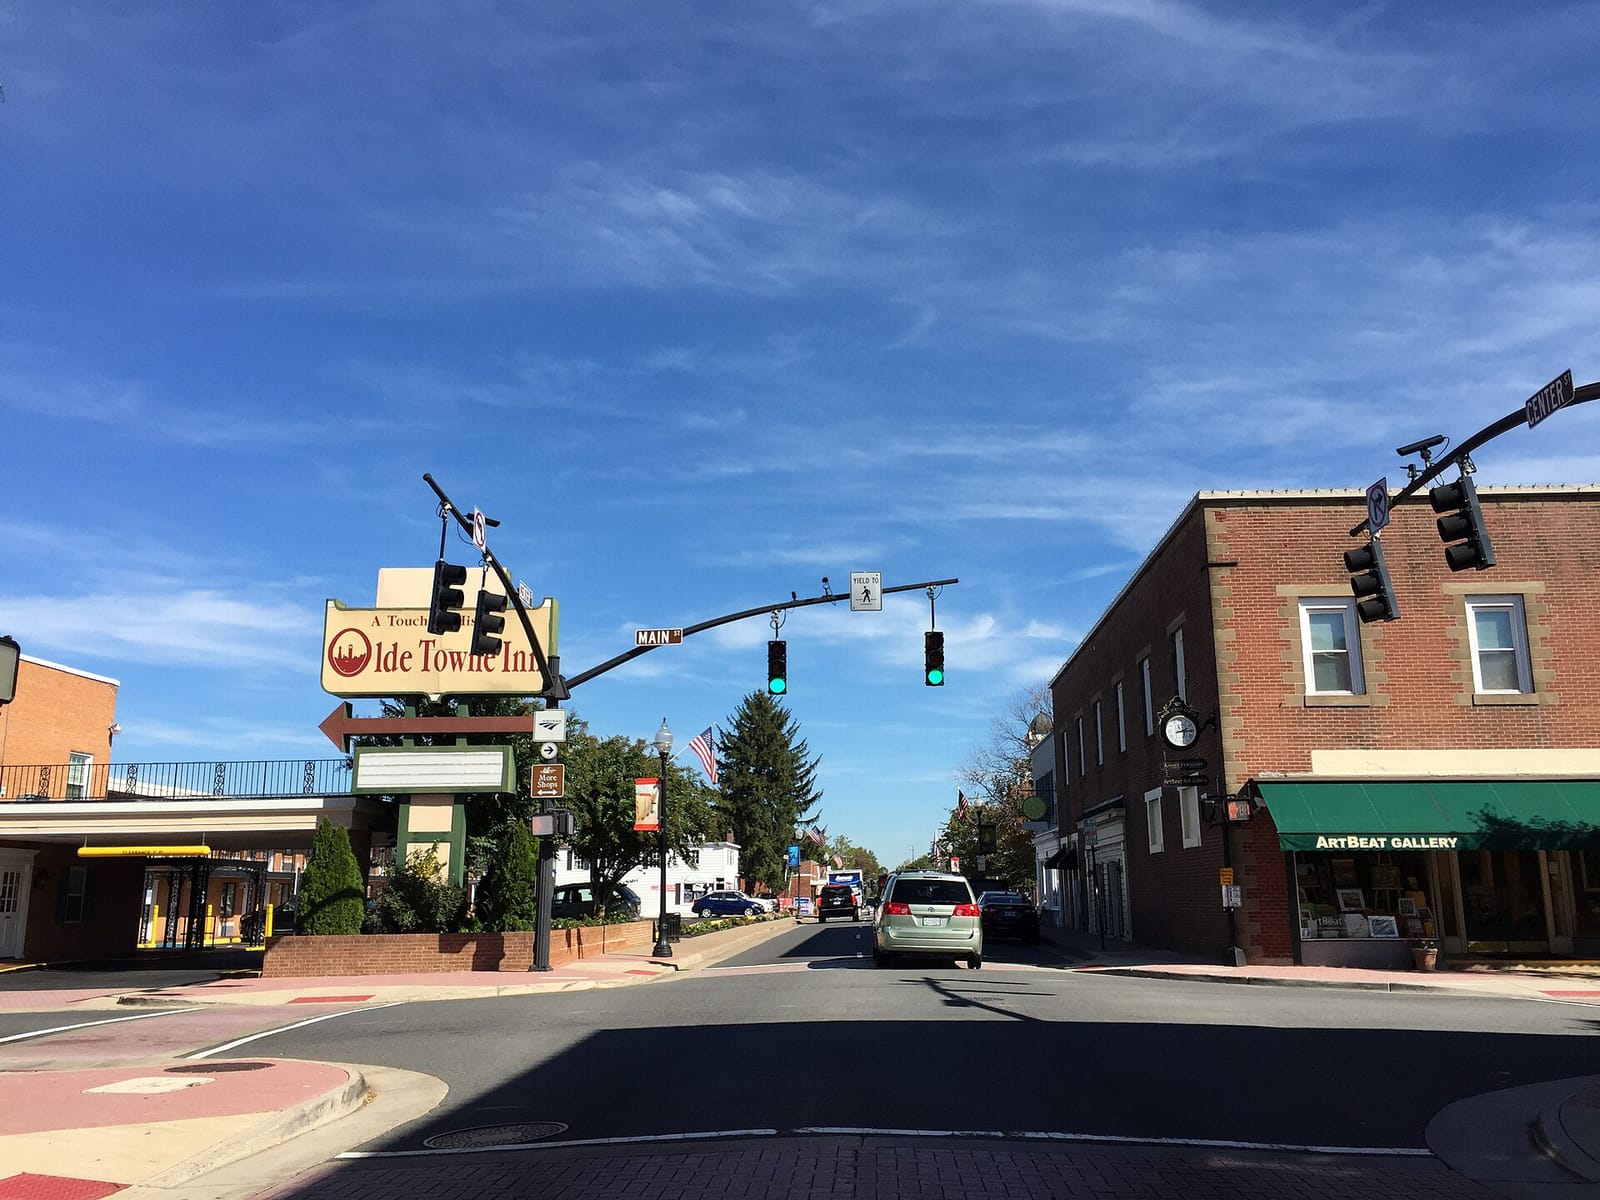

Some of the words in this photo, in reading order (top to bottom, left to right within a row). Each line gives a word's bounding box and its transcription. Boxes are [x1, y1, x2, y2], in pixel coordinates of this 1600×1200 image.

[1526, 379, 1565, 425] CENTER
[371, 615, 381, 627] A
[387, 615, 428, 627] Touch
[638, 630, 670, 644] MAIN
[673, 629, 681, 637] ST
[419, 639, 495, 672] Towne
[537, 781, 558, 789] Shops
[1391, 837, 1458, 848] GALLERY
